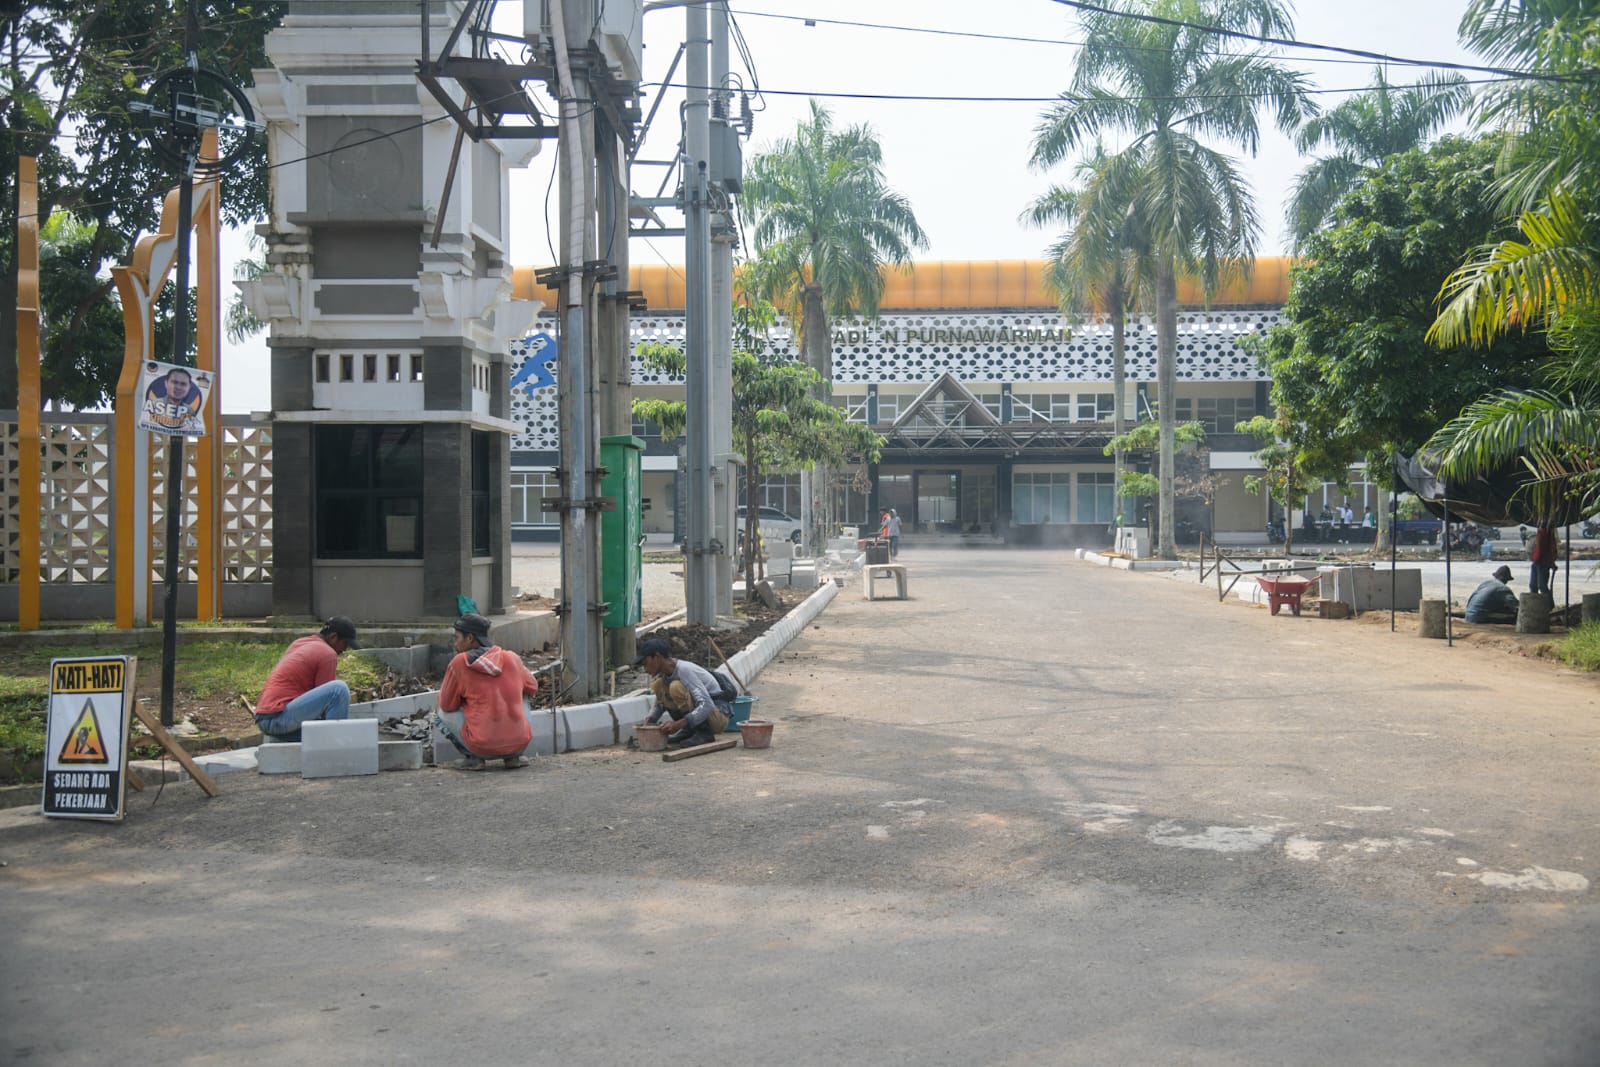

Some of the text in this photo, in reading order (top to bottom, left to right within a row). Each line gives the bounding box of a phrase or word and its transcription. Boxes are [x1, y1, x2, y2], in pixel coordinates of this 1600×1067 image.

[906, 329, 1072, 344] PURNAWARMAN
[144, 399, 188, 418] ASEP
[57, 665, 121, 689] HATI-HATI
[54, 773, 110, 789] SEDANG ADA
[55, 793, 107, 809] PEKERJAAN
